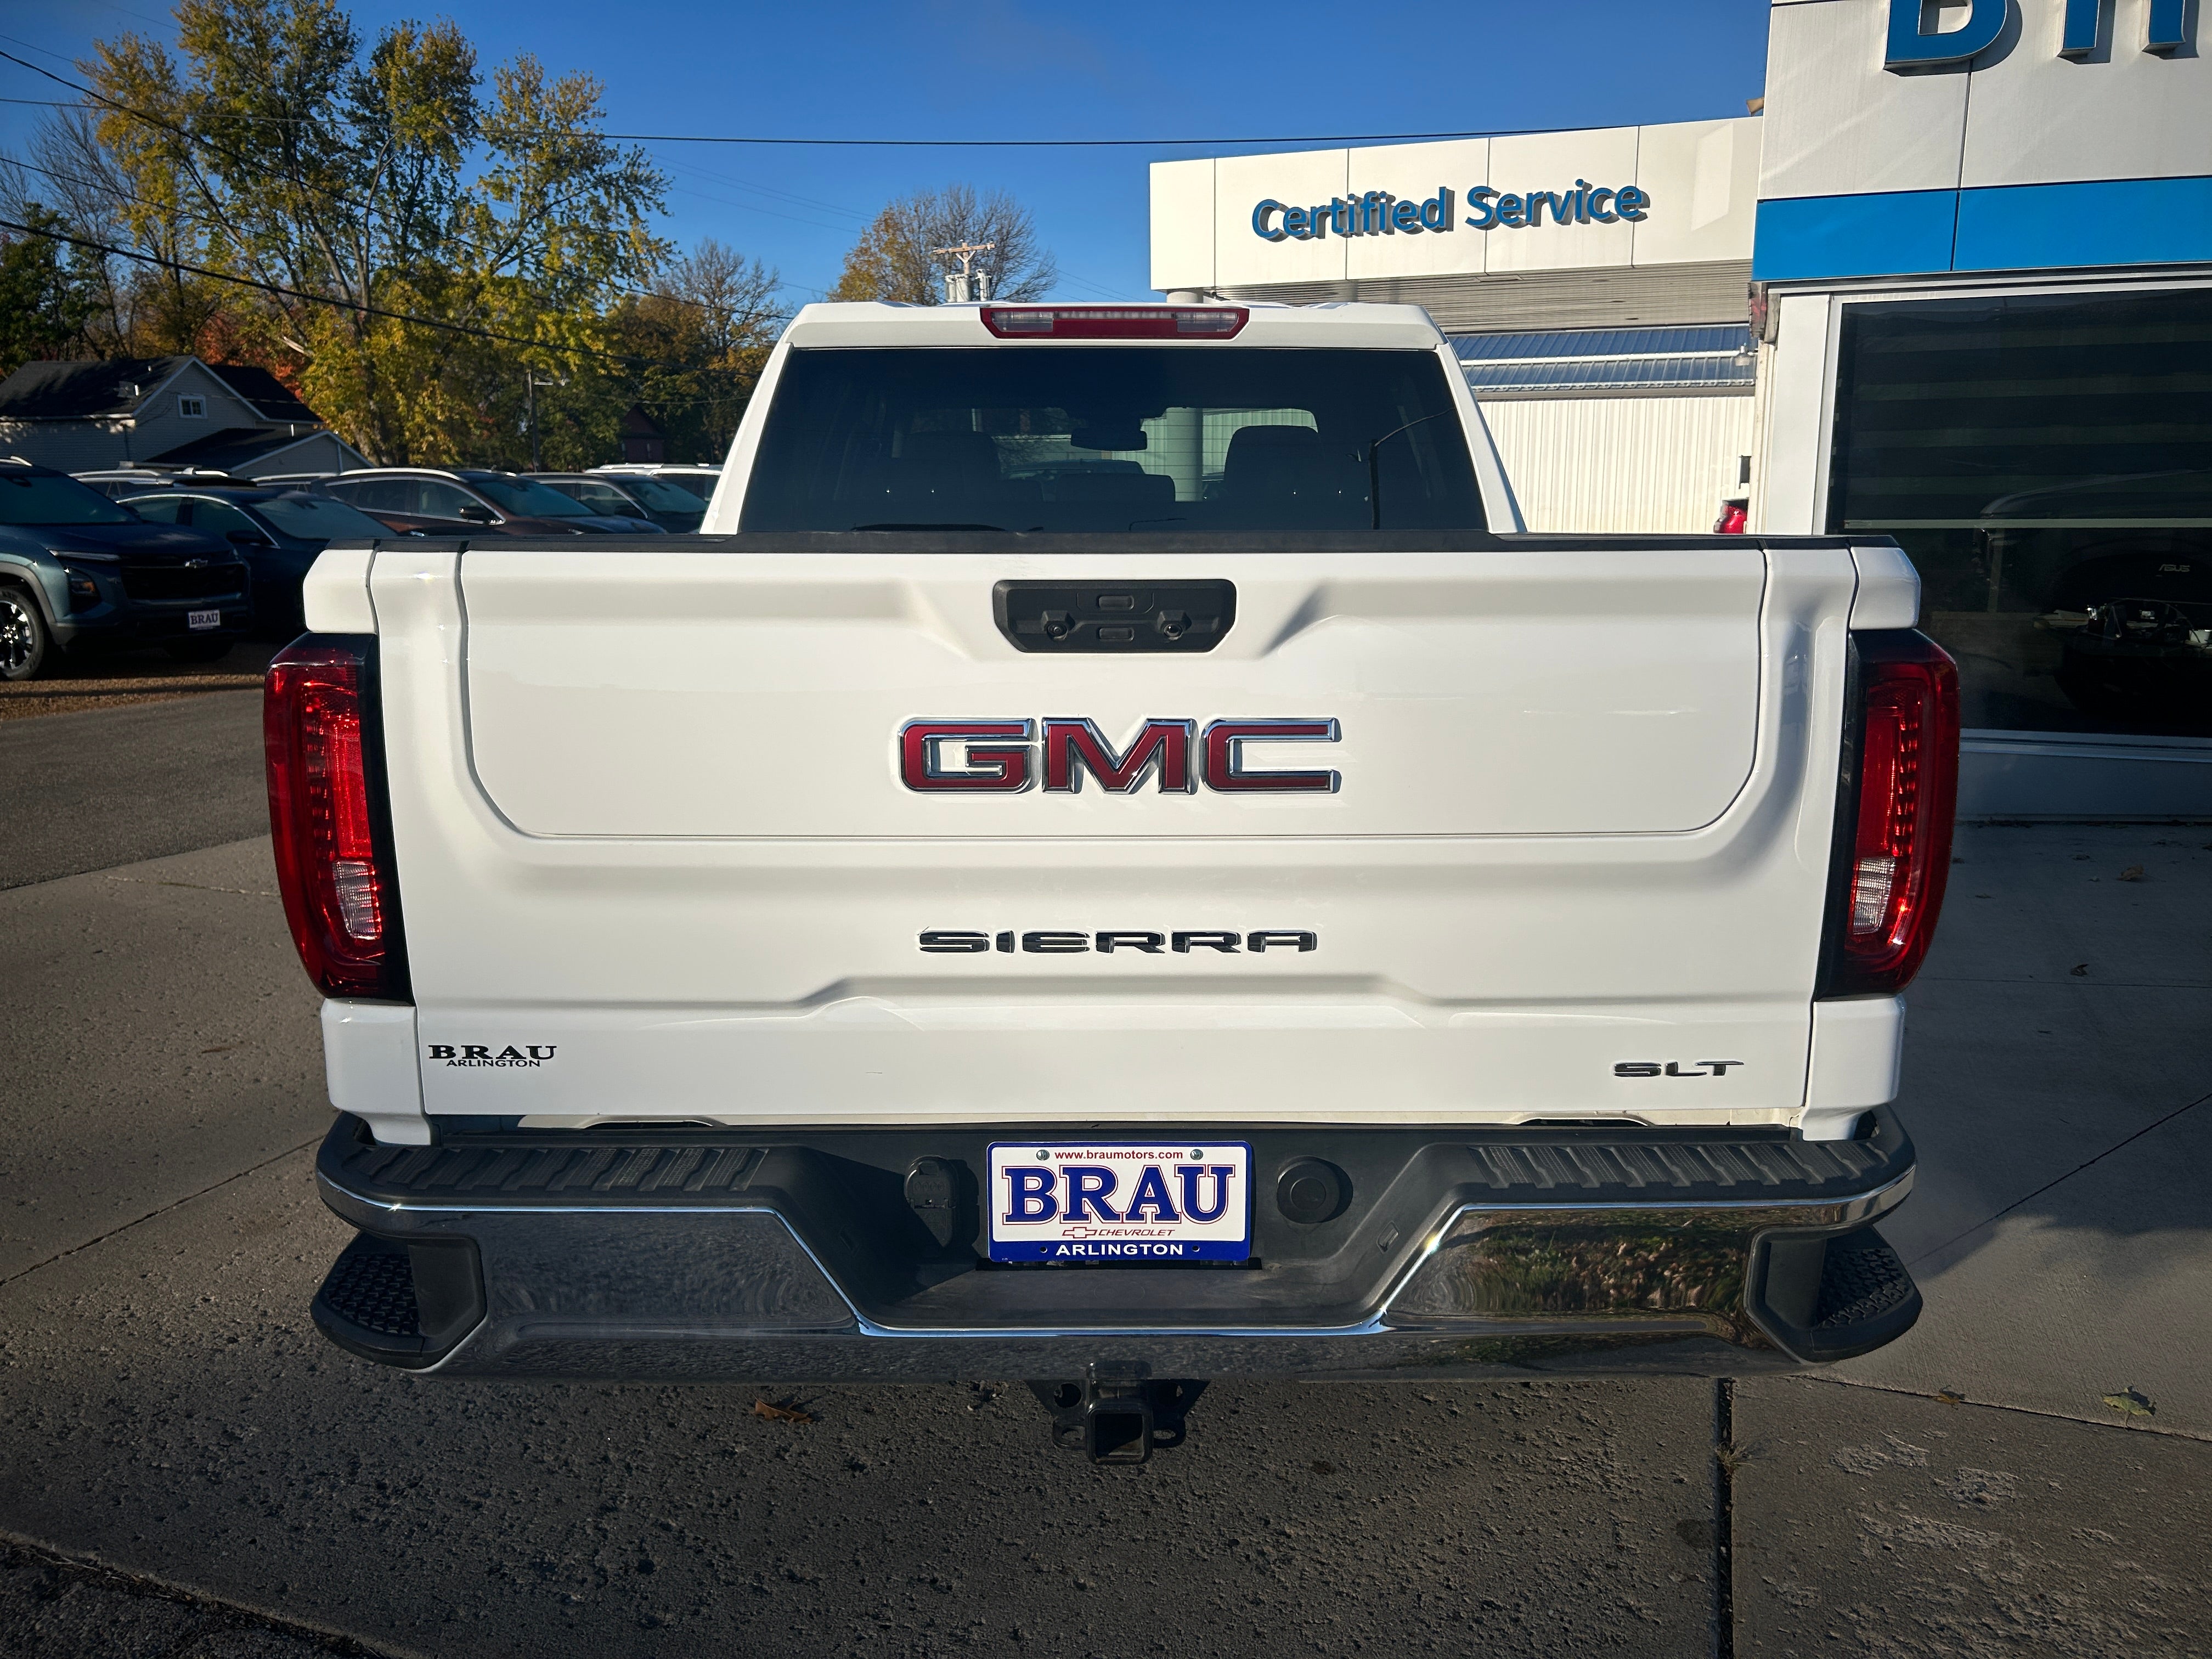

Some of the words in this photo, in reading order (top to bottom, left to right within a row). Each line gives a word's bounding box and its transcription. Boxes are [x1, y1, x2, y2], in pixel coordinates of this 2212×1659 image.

[1252, 187, 1454, 242] Certified
[1465, 179, 1650, 230] Service
[2159, 564, 2191, 572] ASUS
[190, 613, 218, 625] BRAU
[898, 717, 1341, 794] GMC
[918, 930, 1317, 953] SIERRA
[428, 1045, 557, 1060] BRAU
[1613, 1061, 1745, 1077] SLT
[1054, 1149, 1183, 1160] www.braumotors.com
[1001, 1164, 1235, 1226] BRAU
[1056, 1244, 1183, 1256] ARLINGTON
